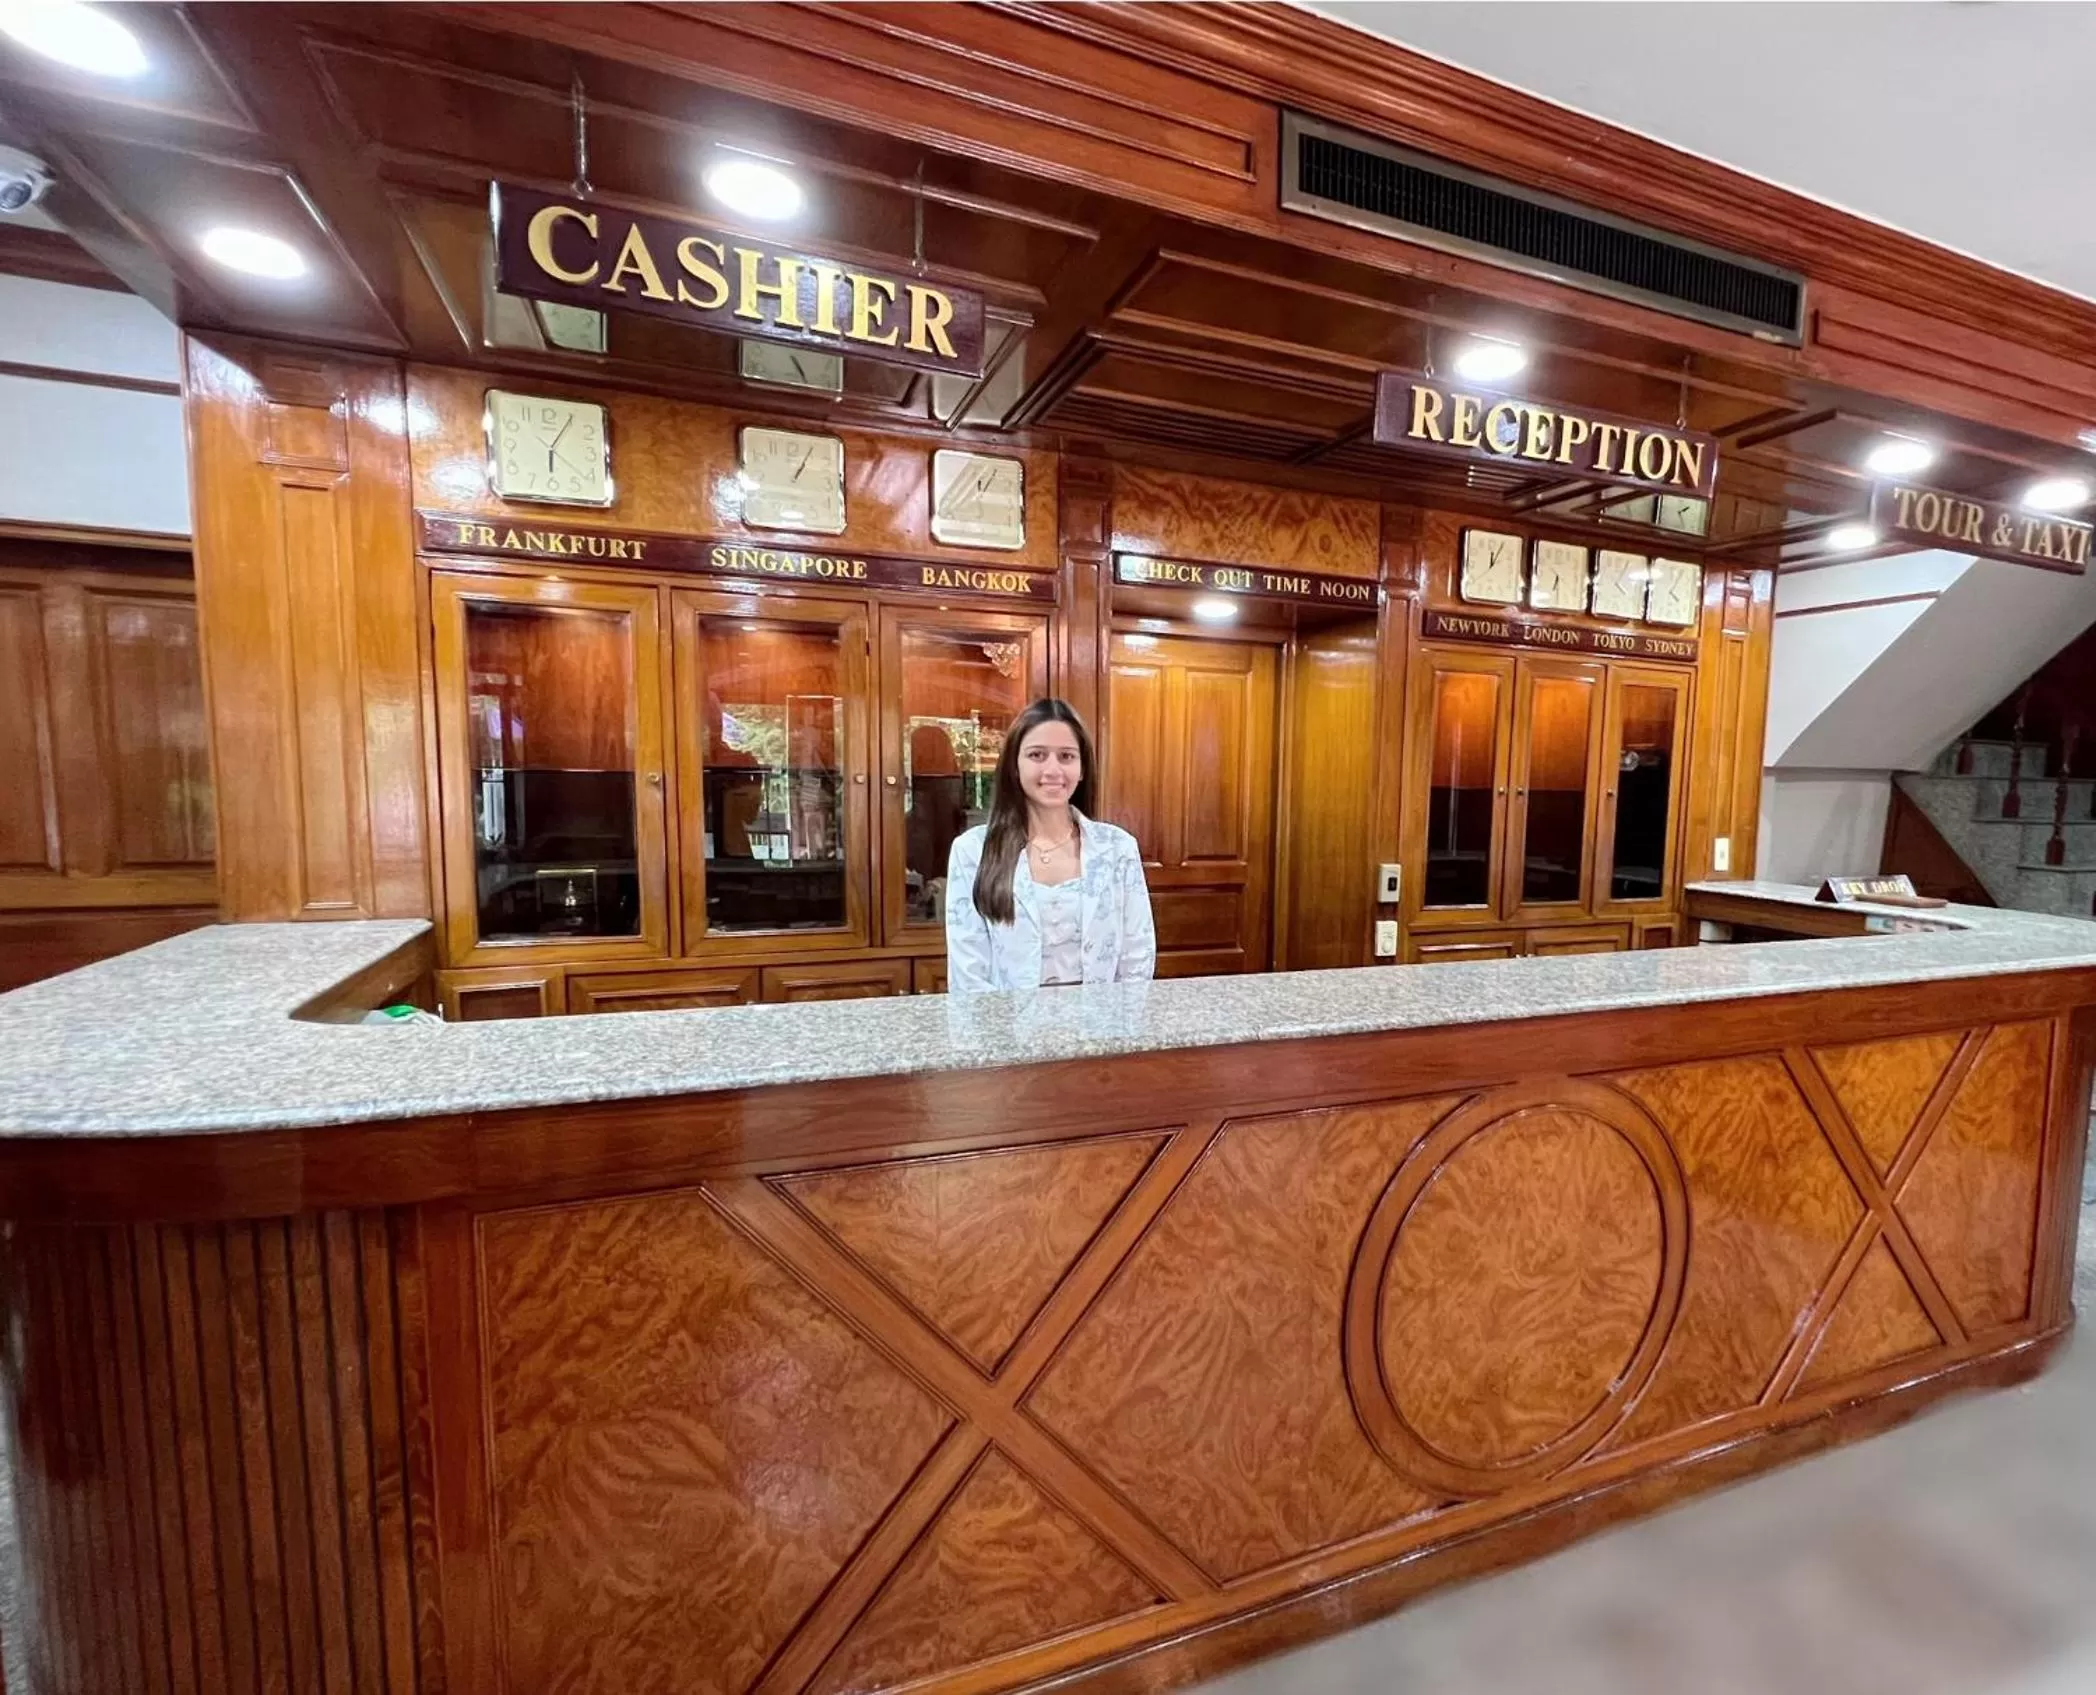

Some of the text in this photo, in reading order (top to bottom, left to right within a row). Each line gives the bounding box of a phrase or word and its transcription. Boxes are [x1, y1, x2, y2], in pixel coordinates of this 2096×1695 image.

[527, 206, 958, 359] CASHIER
[1408, 384, 1705, 487] RECEPTION
[457, 524, 1031, 593] FRANKFURT SINGAPORE BANGKOK
[1894, 487, 2091, 564] TOUR & TAXI
[1136, 559, 1370, 600] CHECK OUT TIME NOON
[1437, 617, 1694, 656] NEWYORK LONDON TOKYO SYDNEY
[1840, 881, 1869, 895] KEY
